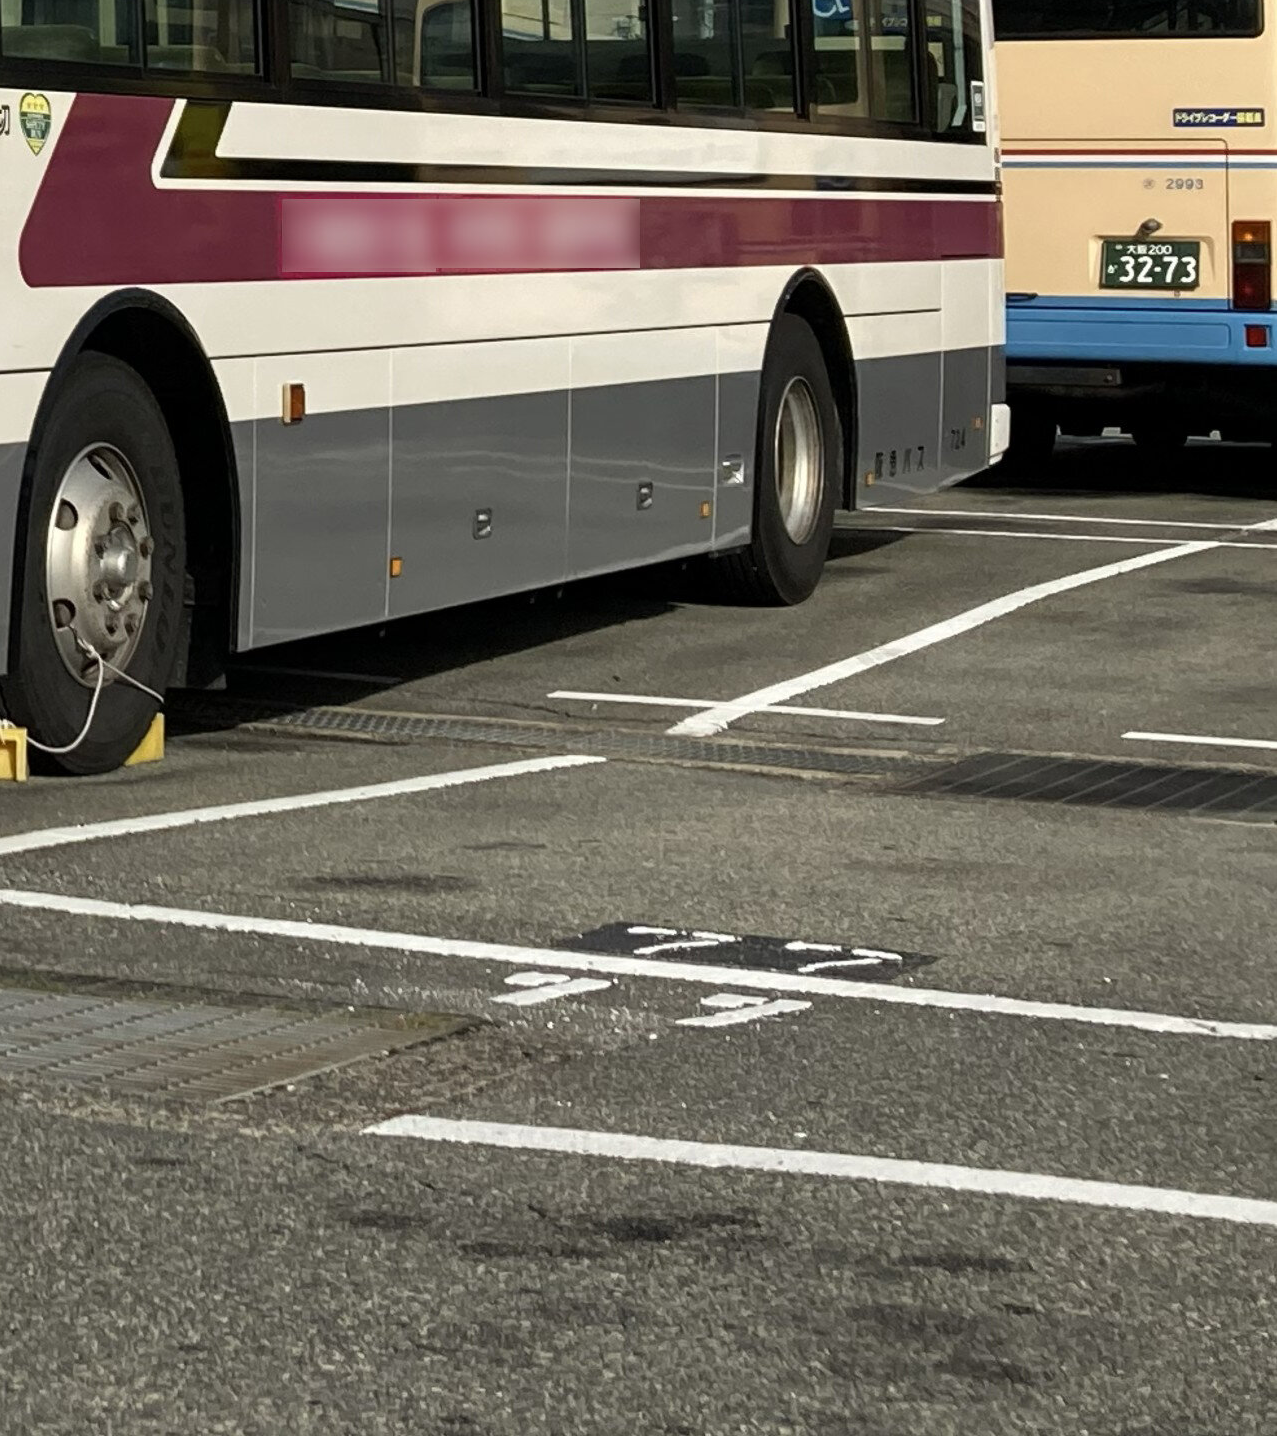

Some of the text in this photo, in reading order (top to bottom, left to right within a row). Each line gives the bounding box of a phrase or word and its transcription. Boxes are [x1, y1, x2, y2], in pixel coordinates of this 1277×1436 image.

[1174, 111, 1263, 124] ドライブレコーダー
[1118, 255, 1197, 283] 32-73
